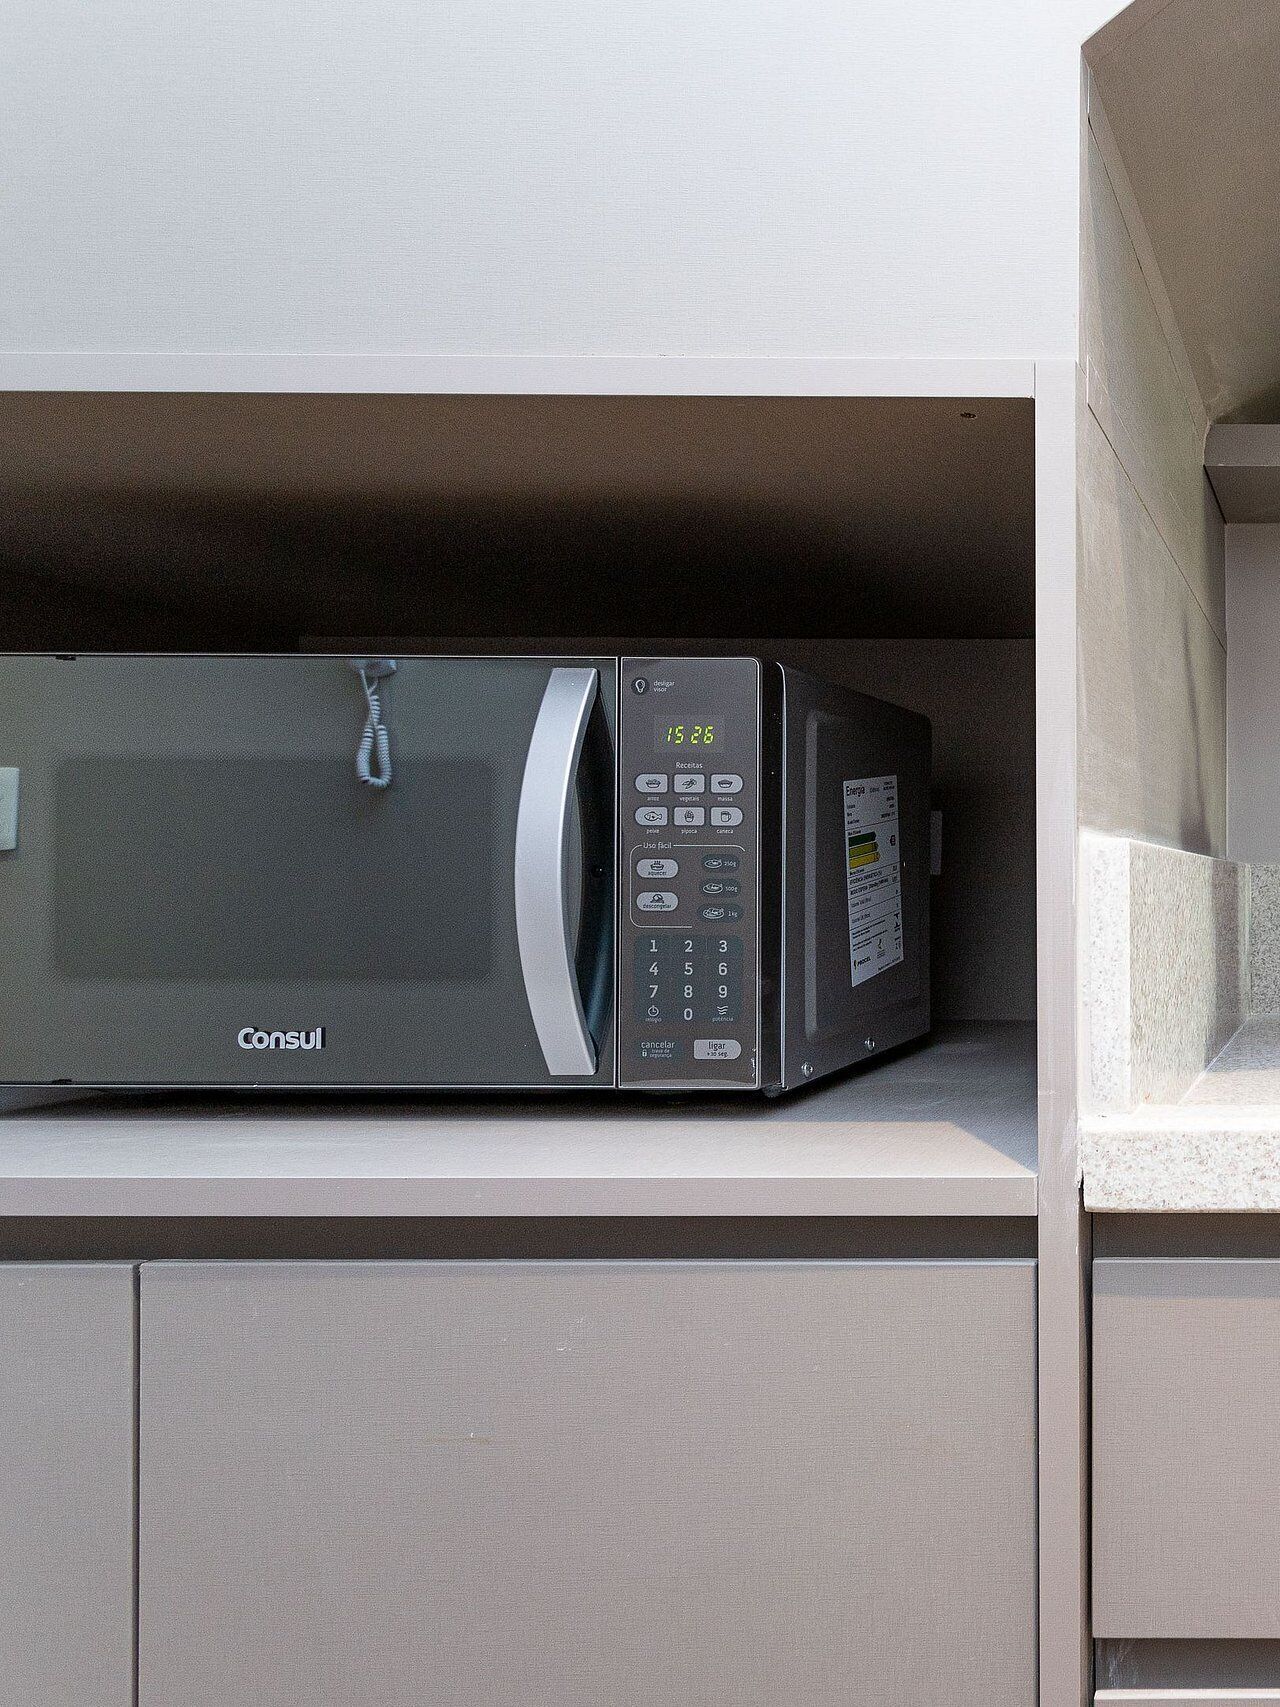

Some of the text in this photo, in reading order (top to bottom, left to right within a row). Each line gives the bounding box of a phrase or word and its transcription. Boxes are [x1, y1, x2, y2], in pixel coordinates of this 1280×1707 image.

[675, 761, 703, 769] Receitas
[845, 784, 866, 798] Energia
[649, 939, 658, 952] 1
[684, 939, 693, 953] 2
[718, 940, 728, 953] 3
[648, 961, 659, 976] 4
[684, 962, 694, 976] 5
[718, 962, 728, 976] 6
[649, 984, 659, 998] 7
[683, 984, 693, 998] 8
[718, 985, 728, 999] 9
[683, 1008, 693, 1021] 0
[237, 1026, 323, 1050] Consul
[640, 1039, 676, 1049] cancelar
[708, 1041, 726, 1052] ligar
